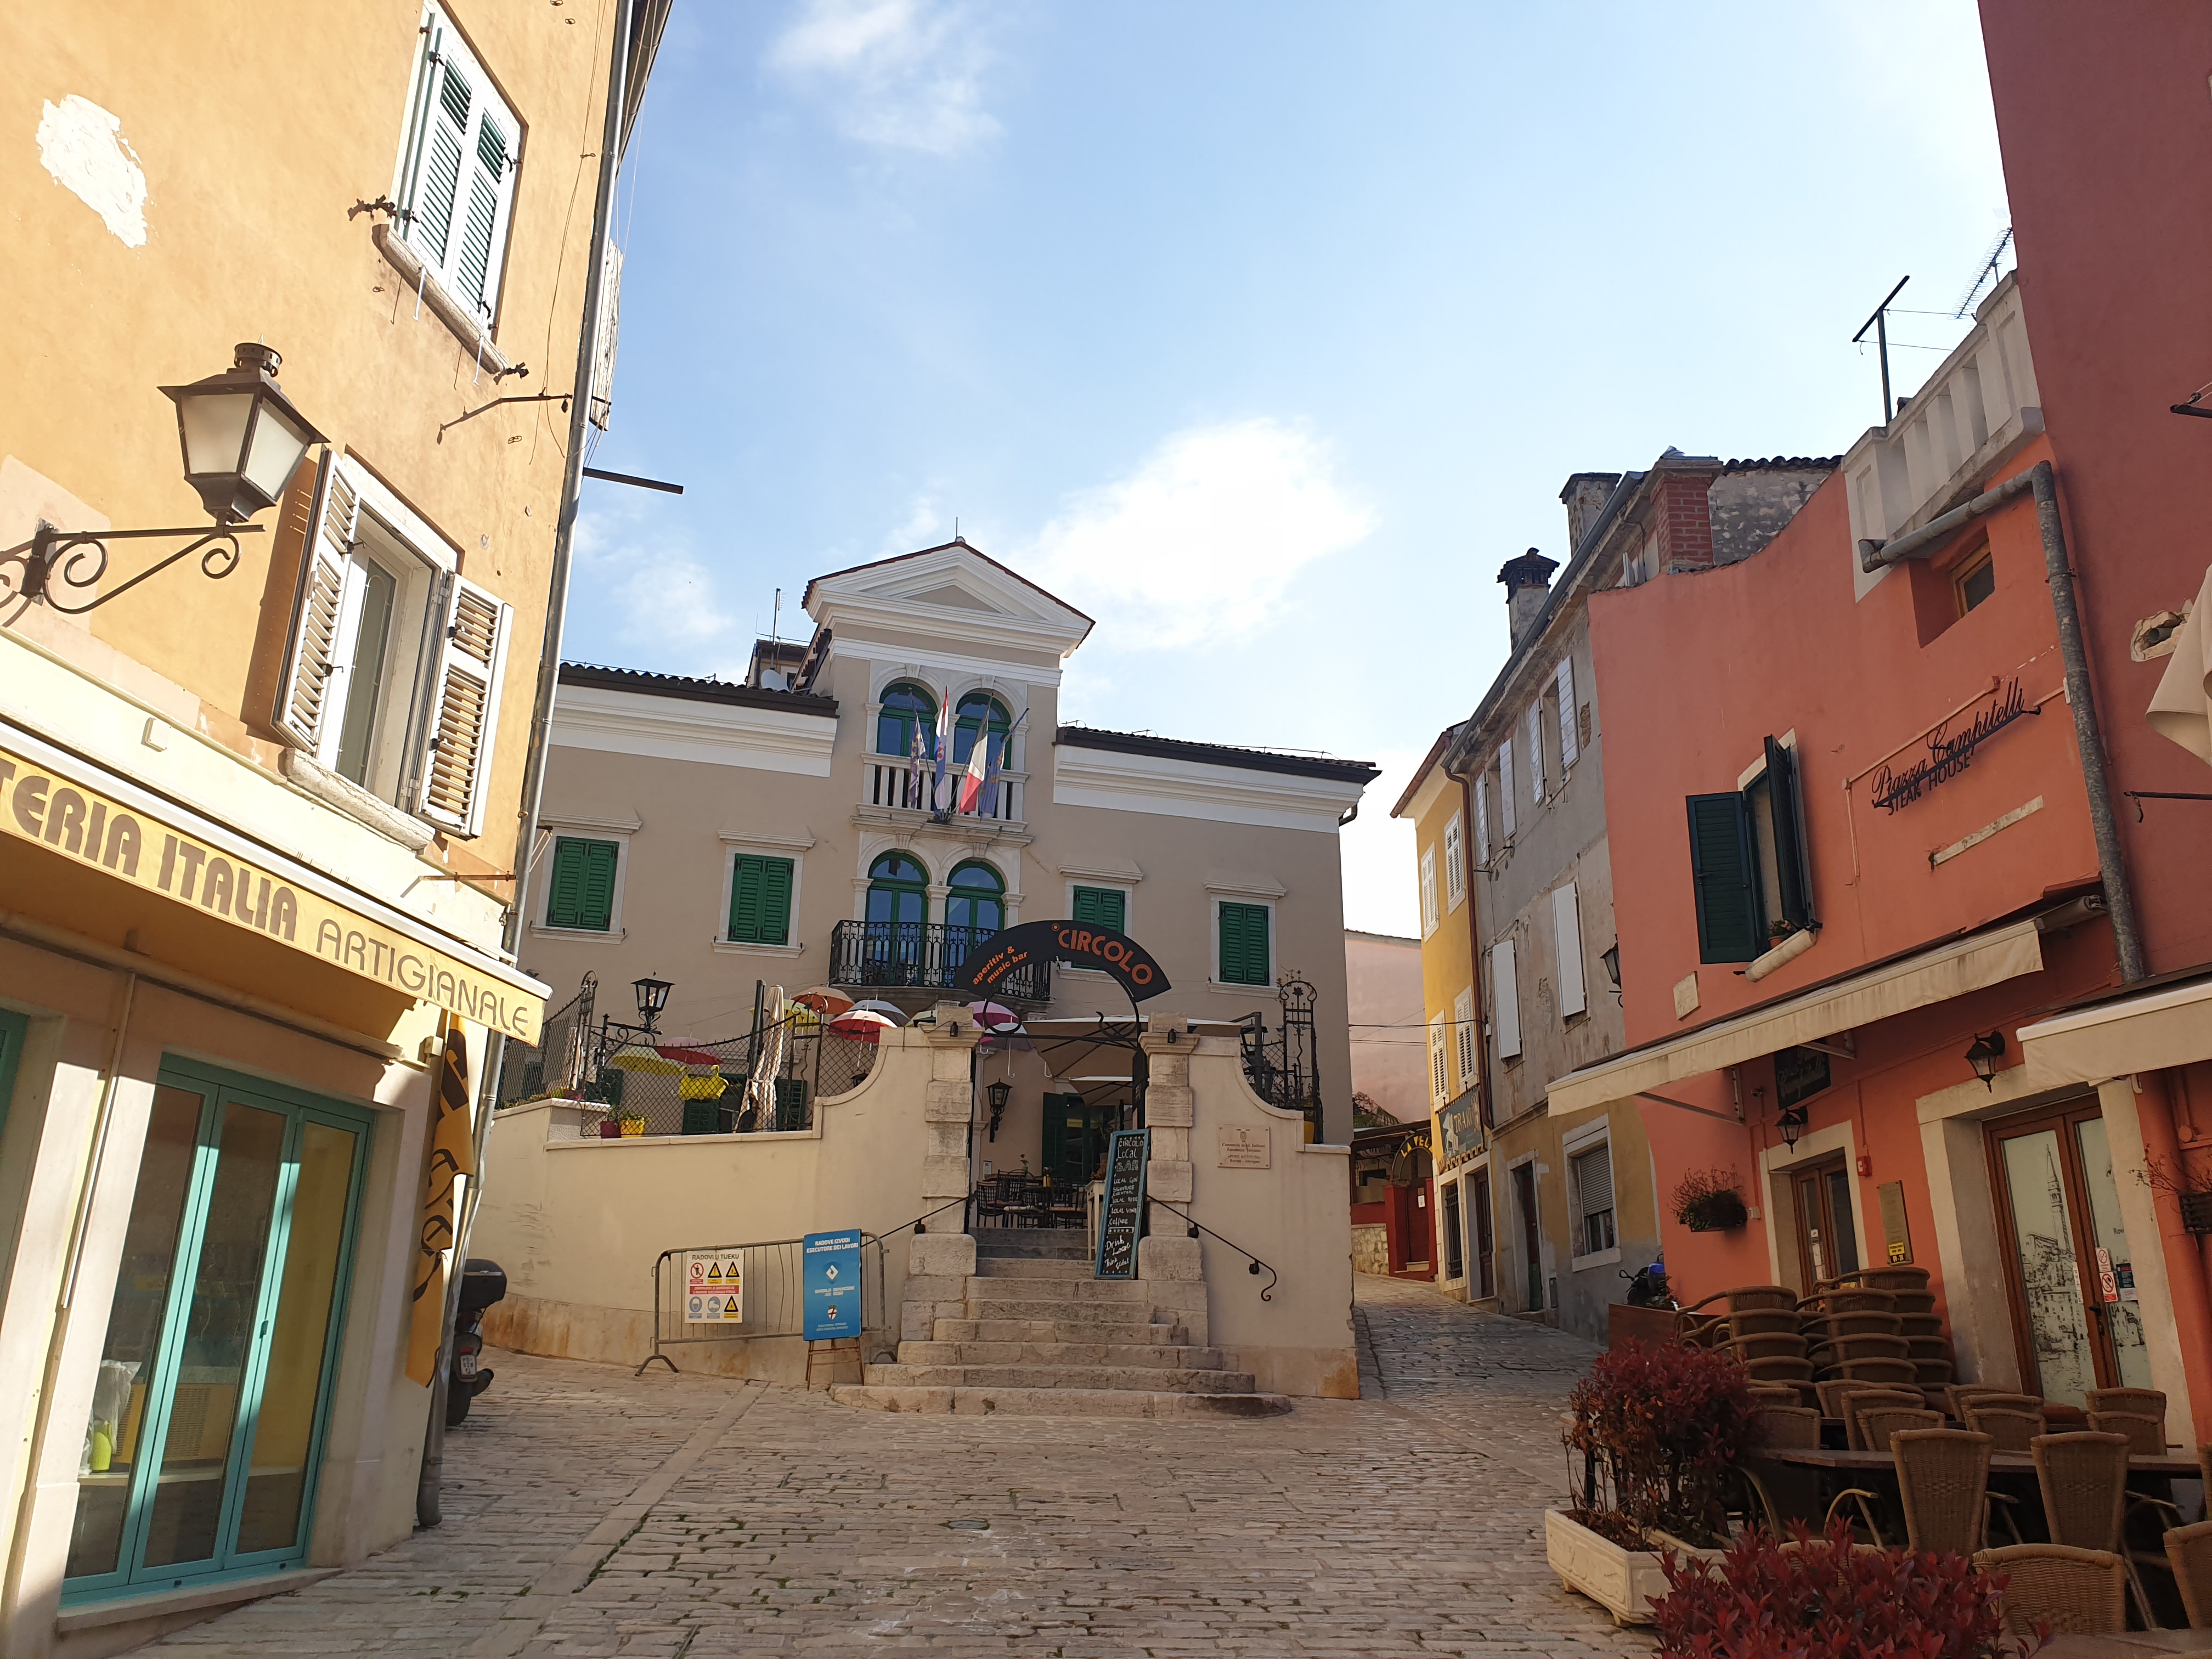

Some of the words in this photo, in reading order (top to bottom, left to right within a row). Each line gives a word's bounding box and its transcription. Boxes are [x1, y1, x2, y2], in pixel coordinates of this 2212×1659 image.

[1871, 758, 1928, 806] Piazza
[1888, 780, 1922, 816] STEAK
[1928, 752, 1971, 791] HOUSE
[157, 833, 298, 943] ITALIA
[316, 918, 529, 1037] ARTIGIANALE
[973, 952, 1004, 985] aperitiv
[1007, 946, 1015, 954] &
[987, 961, 1011, 984] music
[1012, 951, 1028, 963] bar
[1058, 929, 1153, 985] CIRCOLO
[1116, 1159, 1139, 1172] BAR
[1129, 1176, 1138, 1184] GIN
[806, 1245, 833, 1254] ESECUTORE
[1105, 1234, 1125, 1251] Drink
[1112, 1242, 1131, 1256] Local
[1104, 1256, 1118, 1268] Think
